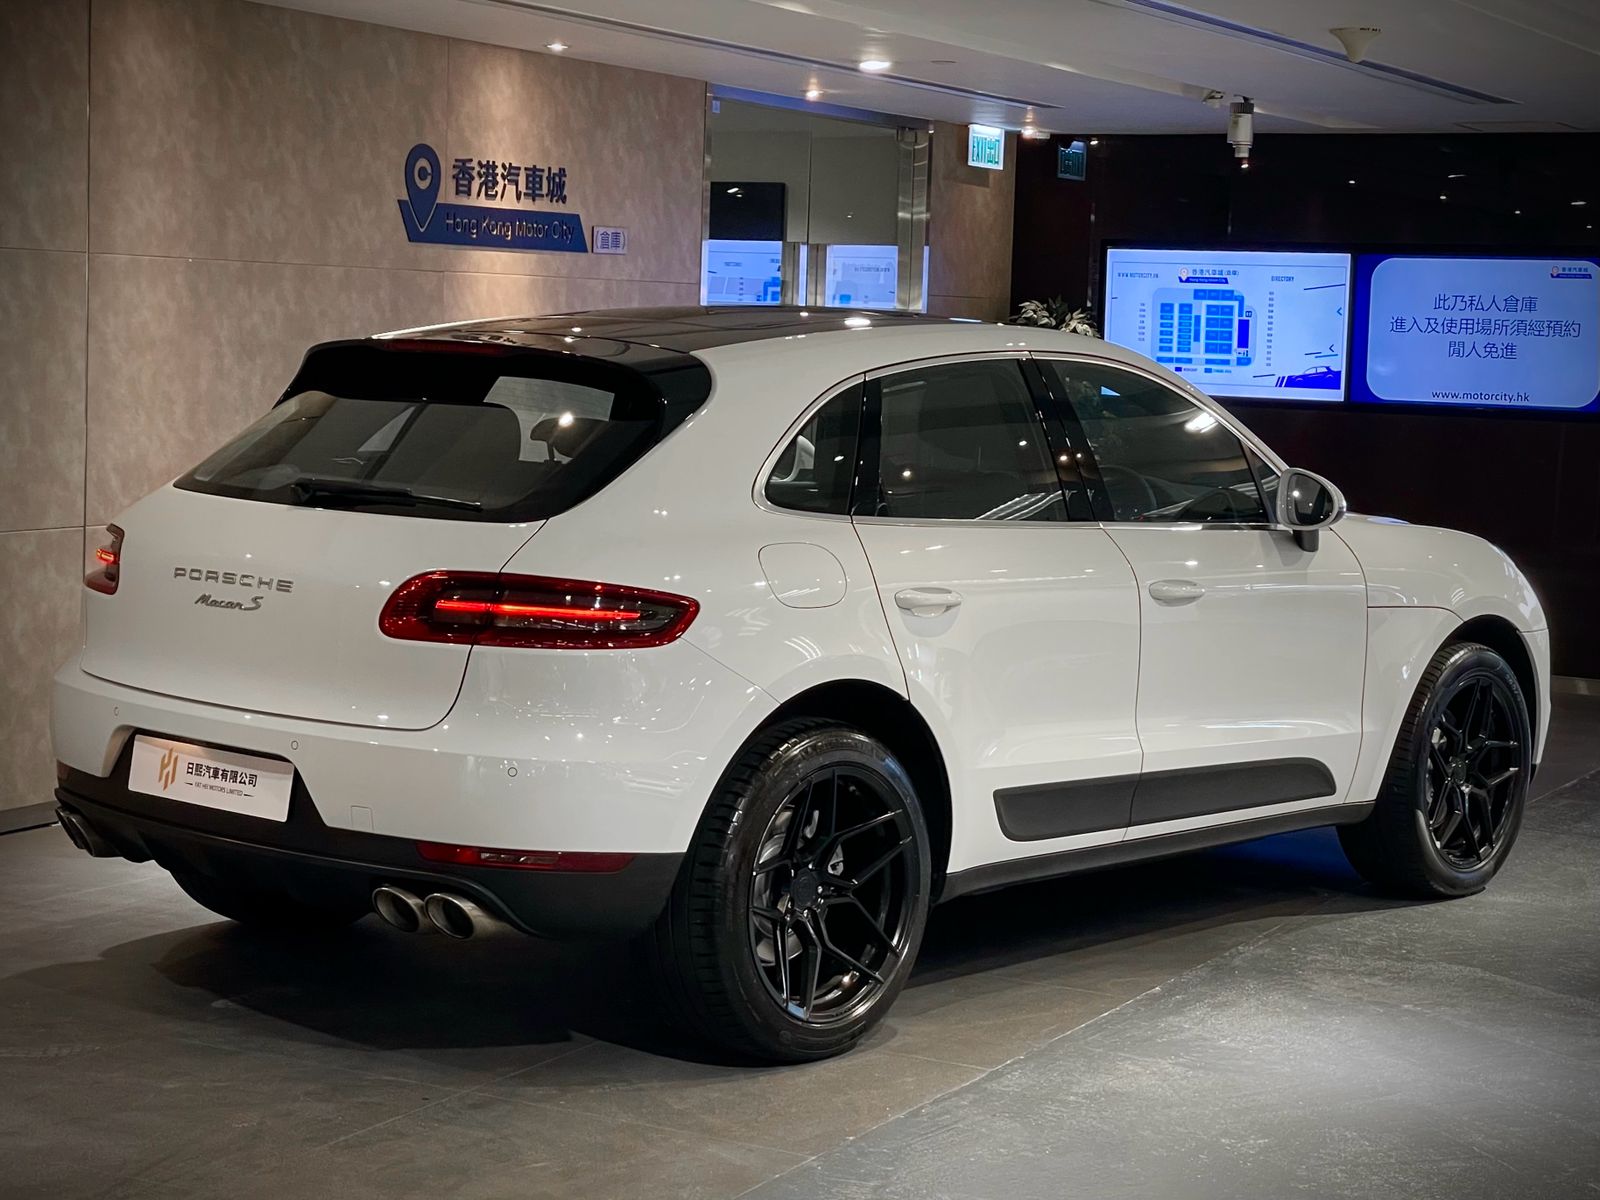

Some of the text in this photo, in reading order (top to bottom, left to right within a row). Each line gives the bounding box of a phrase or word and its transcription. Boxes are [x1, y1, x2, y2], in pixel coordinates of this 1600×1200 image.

[452, 158, 568, 204] 香港汽車城
[446, 211, 574, 244] Hong Kong Motor City
[1433, 293, 1539, 313] 此乃私人倉庫
[1389, 316, 1581, 338] 進入及使用場所須經預約
[1431, 391, 1530, 403] www.motorcity.hk
[173, 567, 294, 593] PORSCHE
[194, 593, 243, 611] Macan
[186, 762, 258, 788] 日熙汽車有限公司
